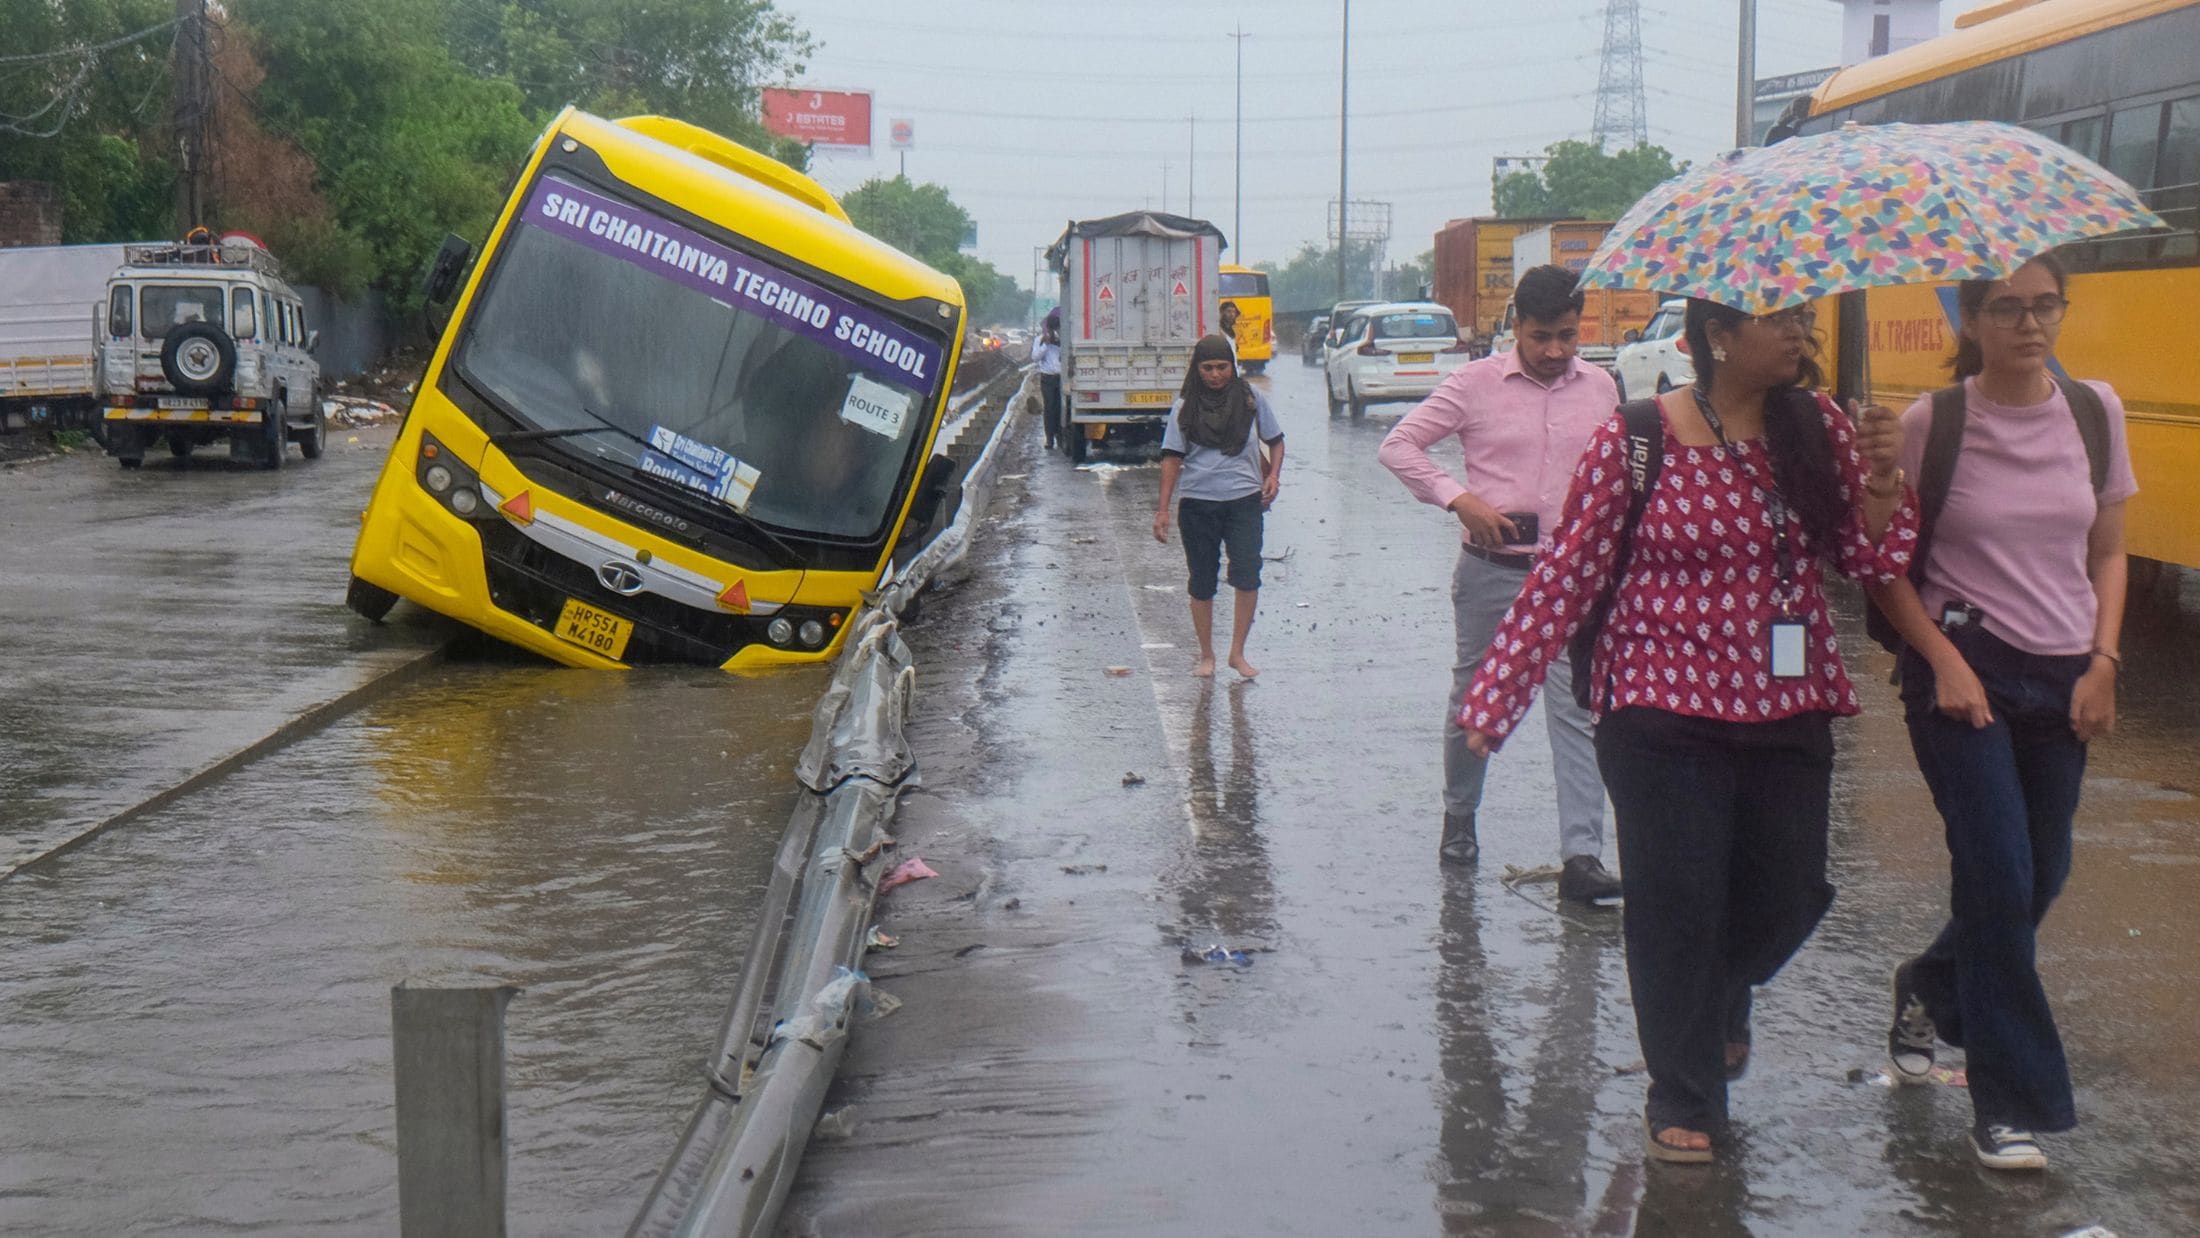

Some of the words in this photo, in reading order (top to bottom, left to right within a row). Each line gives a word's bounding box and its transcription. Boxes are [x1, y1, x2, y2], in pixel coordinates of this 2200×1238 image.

[796, 113, 846, 127] ESTATES
[542, 192, 590, 229] SRI
[588, 210, 729, 286] CHAITANYA
[733, 267, 831, 330] TECHNO
[834, 315, 926, 379] SCHOOL
[1887, 318, 1944, 353] TRAVELS
[848, 395, 889, 421] ROUTE
[890, 413, 900, 424] 3
[674, 435, 686, 451] Sri
[1629, 434, 1649, 493] safari
[605, 490, 688, 531] Marcopolo
[573, 606, 619, 636] HR55A
